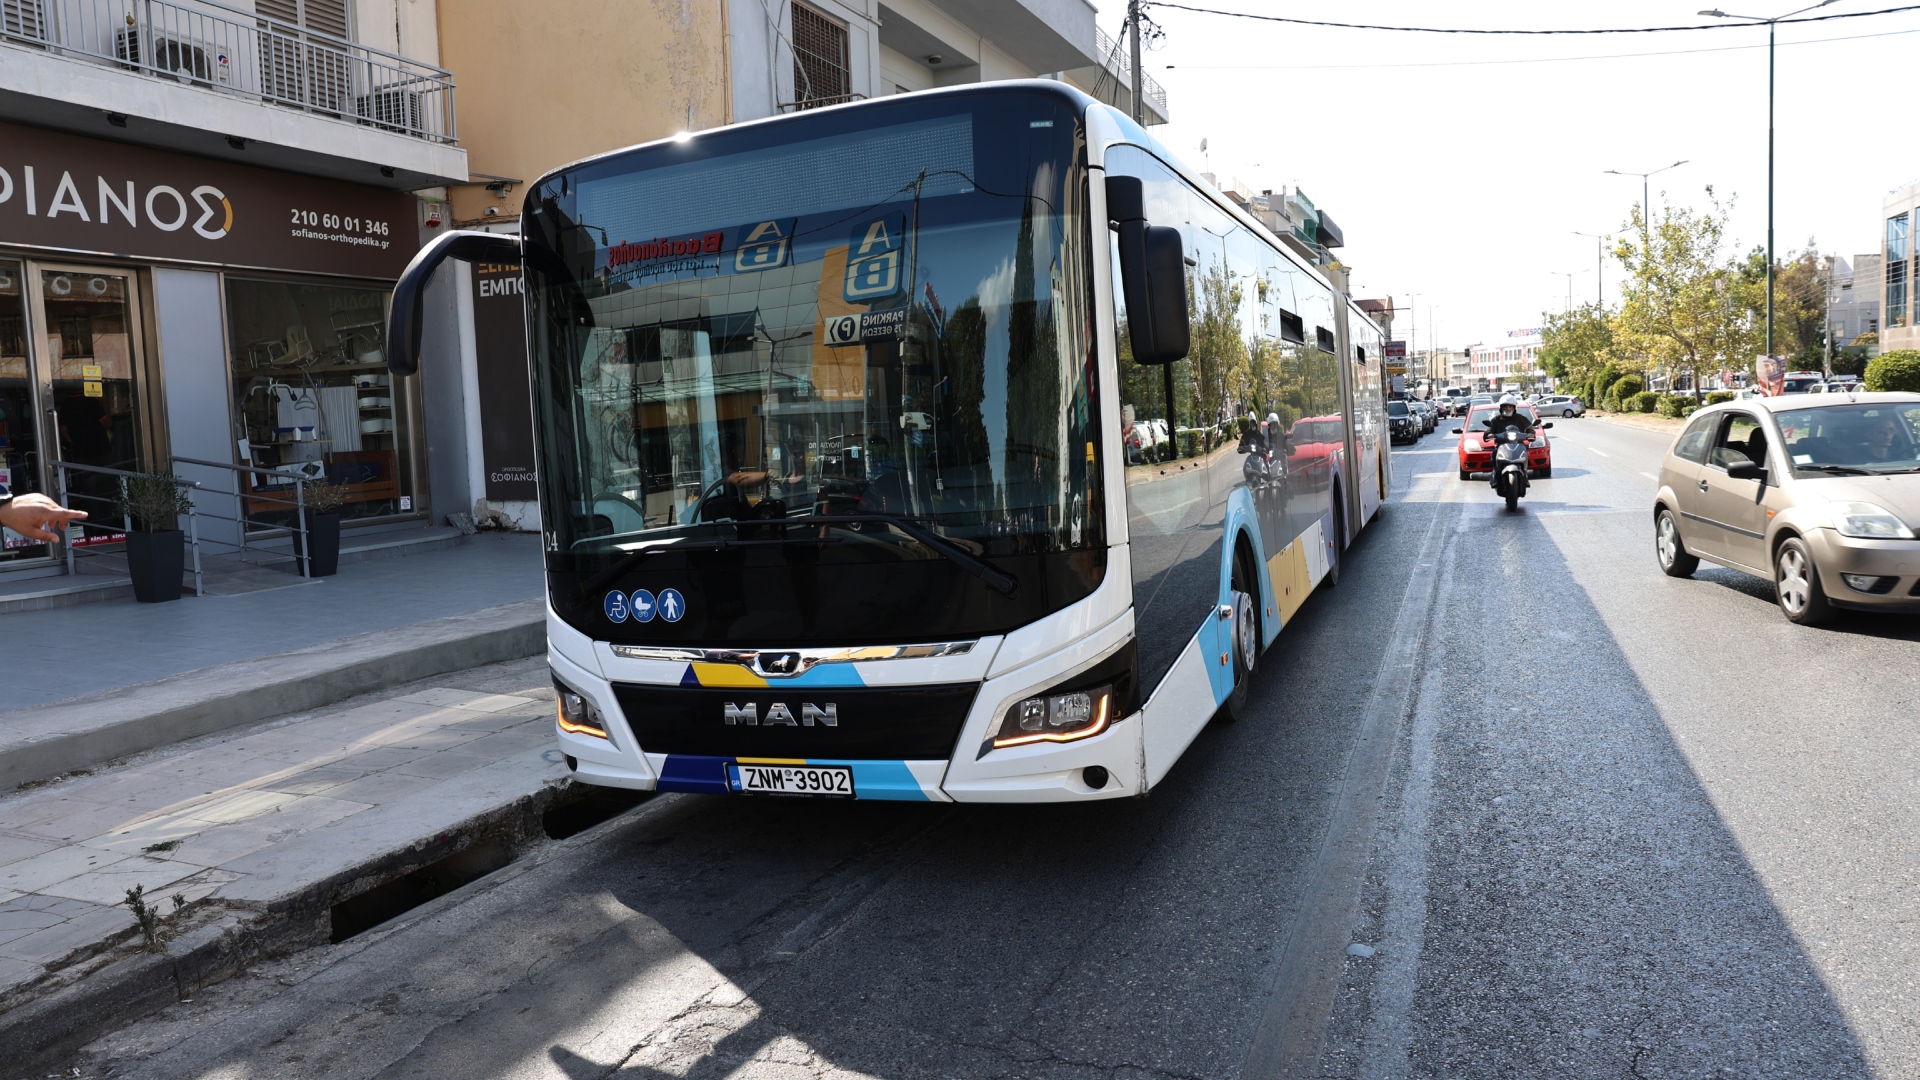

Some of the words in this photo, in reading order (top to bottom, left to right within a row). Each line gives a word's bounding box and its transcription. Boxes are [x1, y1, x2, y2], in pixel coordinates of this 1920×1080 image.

[291, 208, 318, 226] 210
[323, 213, 340, 229] 60
[344, 216, 360, 232] 01
[365, 219, 389, 236] 346
[291, 228, 390, 250] sofianos-orthopedika.gr
[723, 702, 838, 727] MAN
[731, 779, 741, 787] GR
